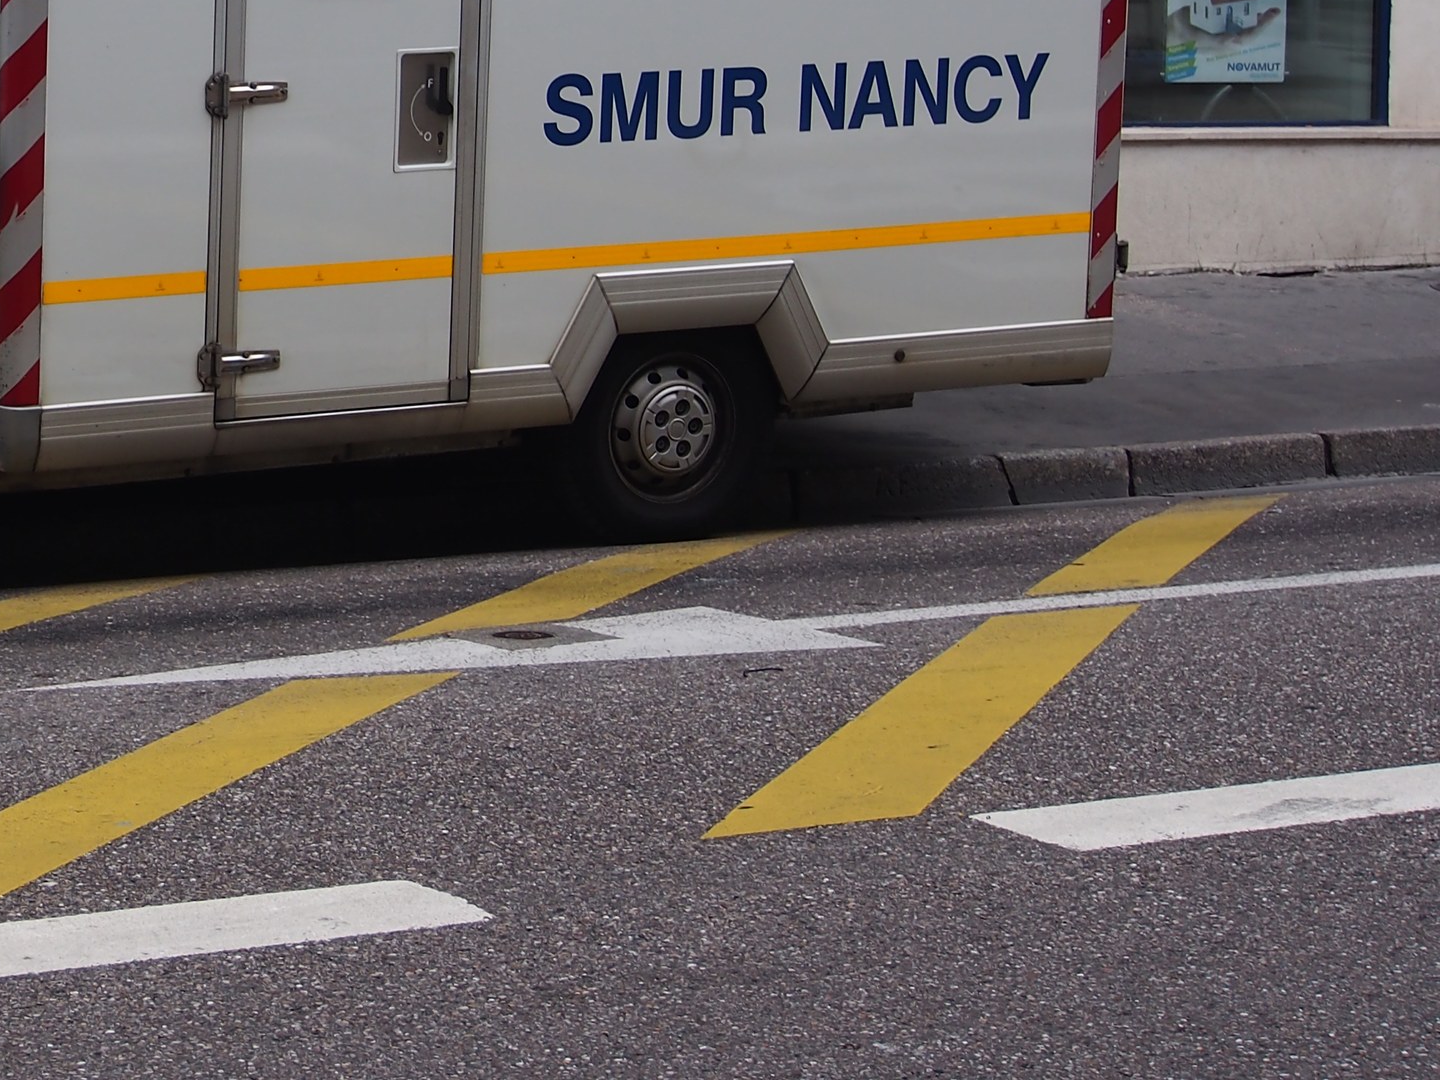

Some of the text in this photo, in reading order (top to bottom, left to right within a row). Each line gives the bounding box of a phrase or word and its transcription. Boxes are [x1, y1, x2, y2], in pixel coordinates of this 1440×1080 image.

[1227, 62, 1280, 72] NOVAMUT
[427, 78, 434, 88] F
[543, 52, 1051, 147] SMUR NANCY
